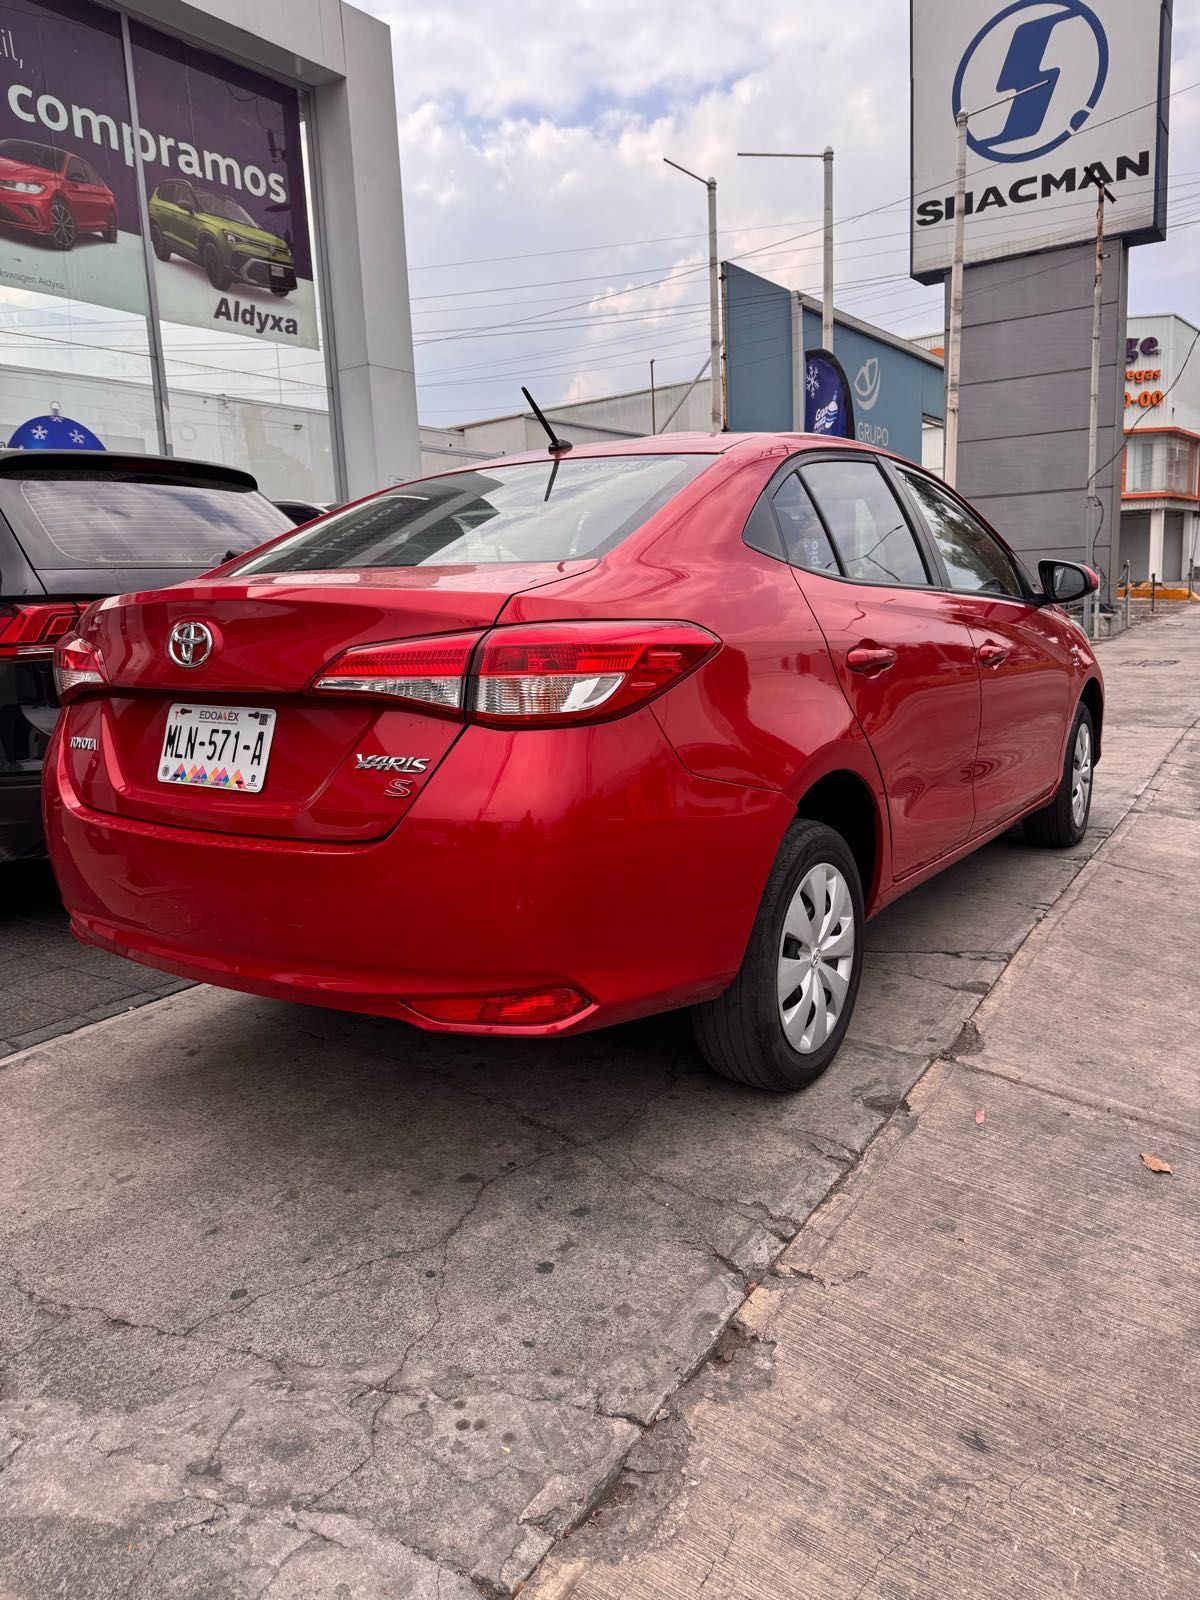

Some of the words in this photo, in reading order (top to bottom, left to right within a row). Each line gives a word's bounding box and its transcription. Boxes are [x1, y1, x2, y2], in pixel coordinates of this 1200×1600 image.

[0, 28, 23, 69] il,
[7, 84, 287, 204] compramos
[916, 150, 1150, 226] SHACMAN
[213, 297, 298, 335] Aldyxa
[856, 421, 889, 447] GRUPO
[164, 724, 264, 766] MLN-571-A
[355, 753, 431, 773] YARIS
[384, 779, 414, 797] S
